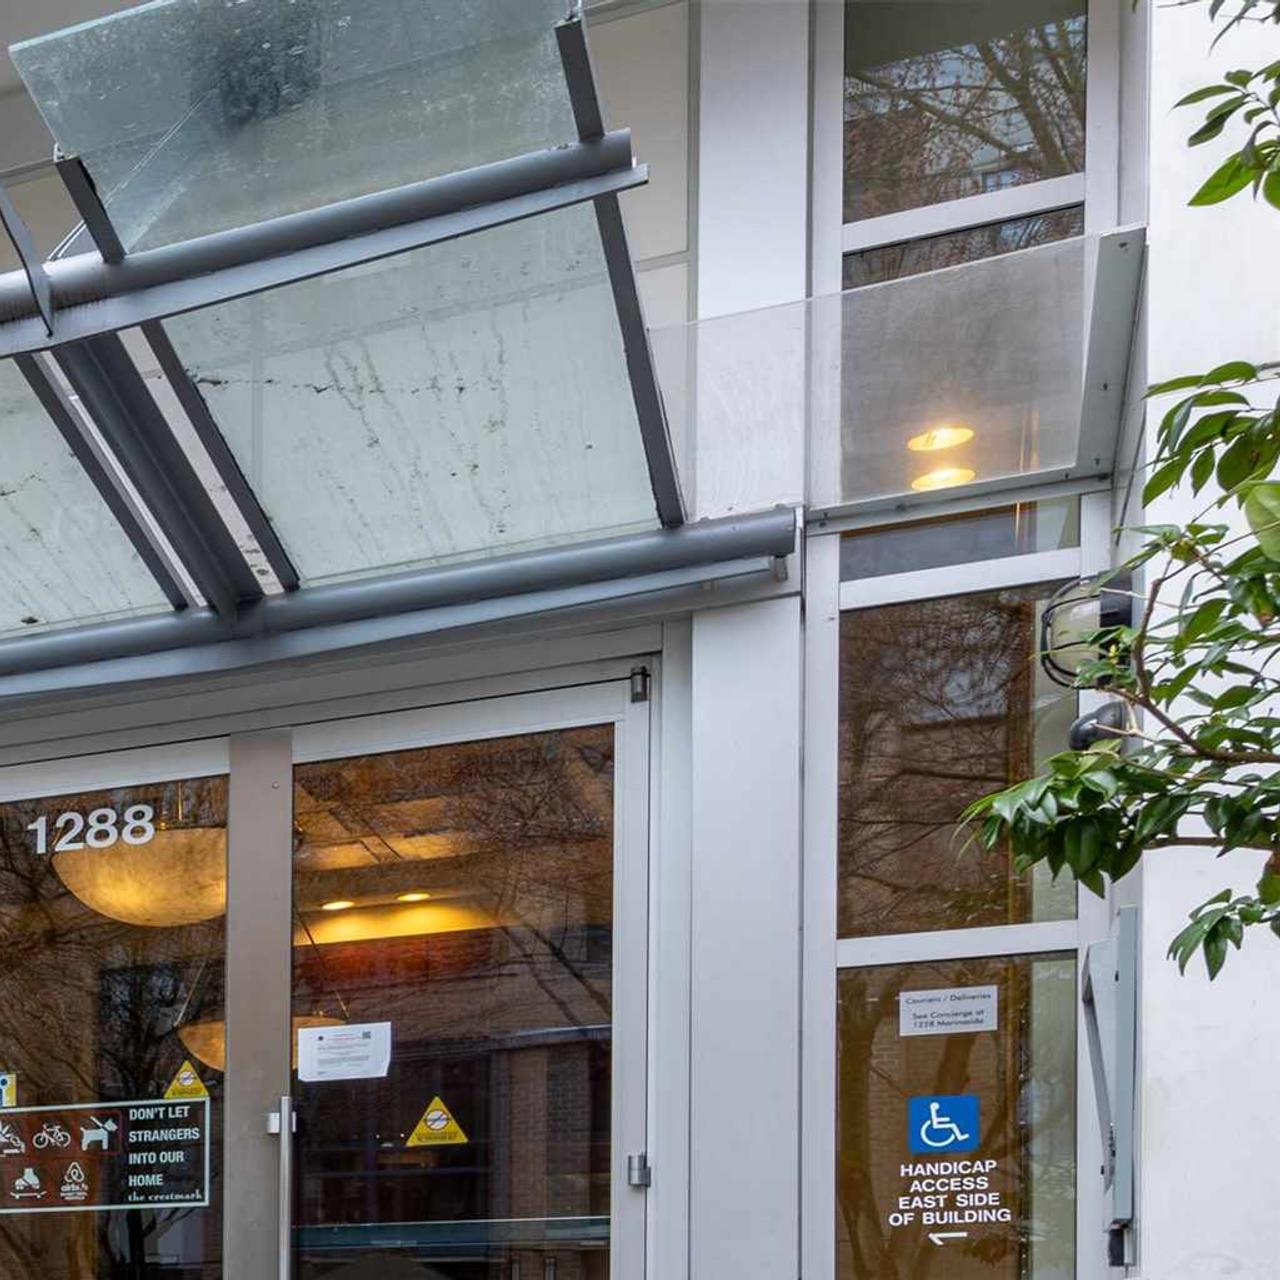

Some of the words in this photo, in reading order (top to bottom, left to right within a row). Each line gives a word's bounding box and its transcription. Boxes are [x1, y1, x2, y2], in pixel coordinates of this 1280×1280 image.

[27, 804, 155, 854] 1288
[905, 996, 941, 1004] Couriers
[950, 993, 991, 1002] Deliveries
[912, 1012, 927, 1020] See
[930, 1010, 973, 1020] Concierge
[129, 1107, 165, 1121] DON'T
[168, 1105, 190, 1119] LET
[128, 1127, 200, 1143] STRANGERS
[128, 1152, 157, 1165] INTO
[160, 1151, 184, 1163] OUR
[900, 1159, 997, 1177] HANDICAP
[128, 1174, 164, 1187] HOME
[909, 1176, 989, 1193] ACCESS
[128, 1191, 145, 1201] the
[148, 1189, 202, 1201] crestmark
[898, 1195, 948, 1210] EAST
[956, 1192, 1000, 1207] SIDE
[888, 1212, 915, 1227] OF
[922, 1209, 1011, 1225] BUILDING
